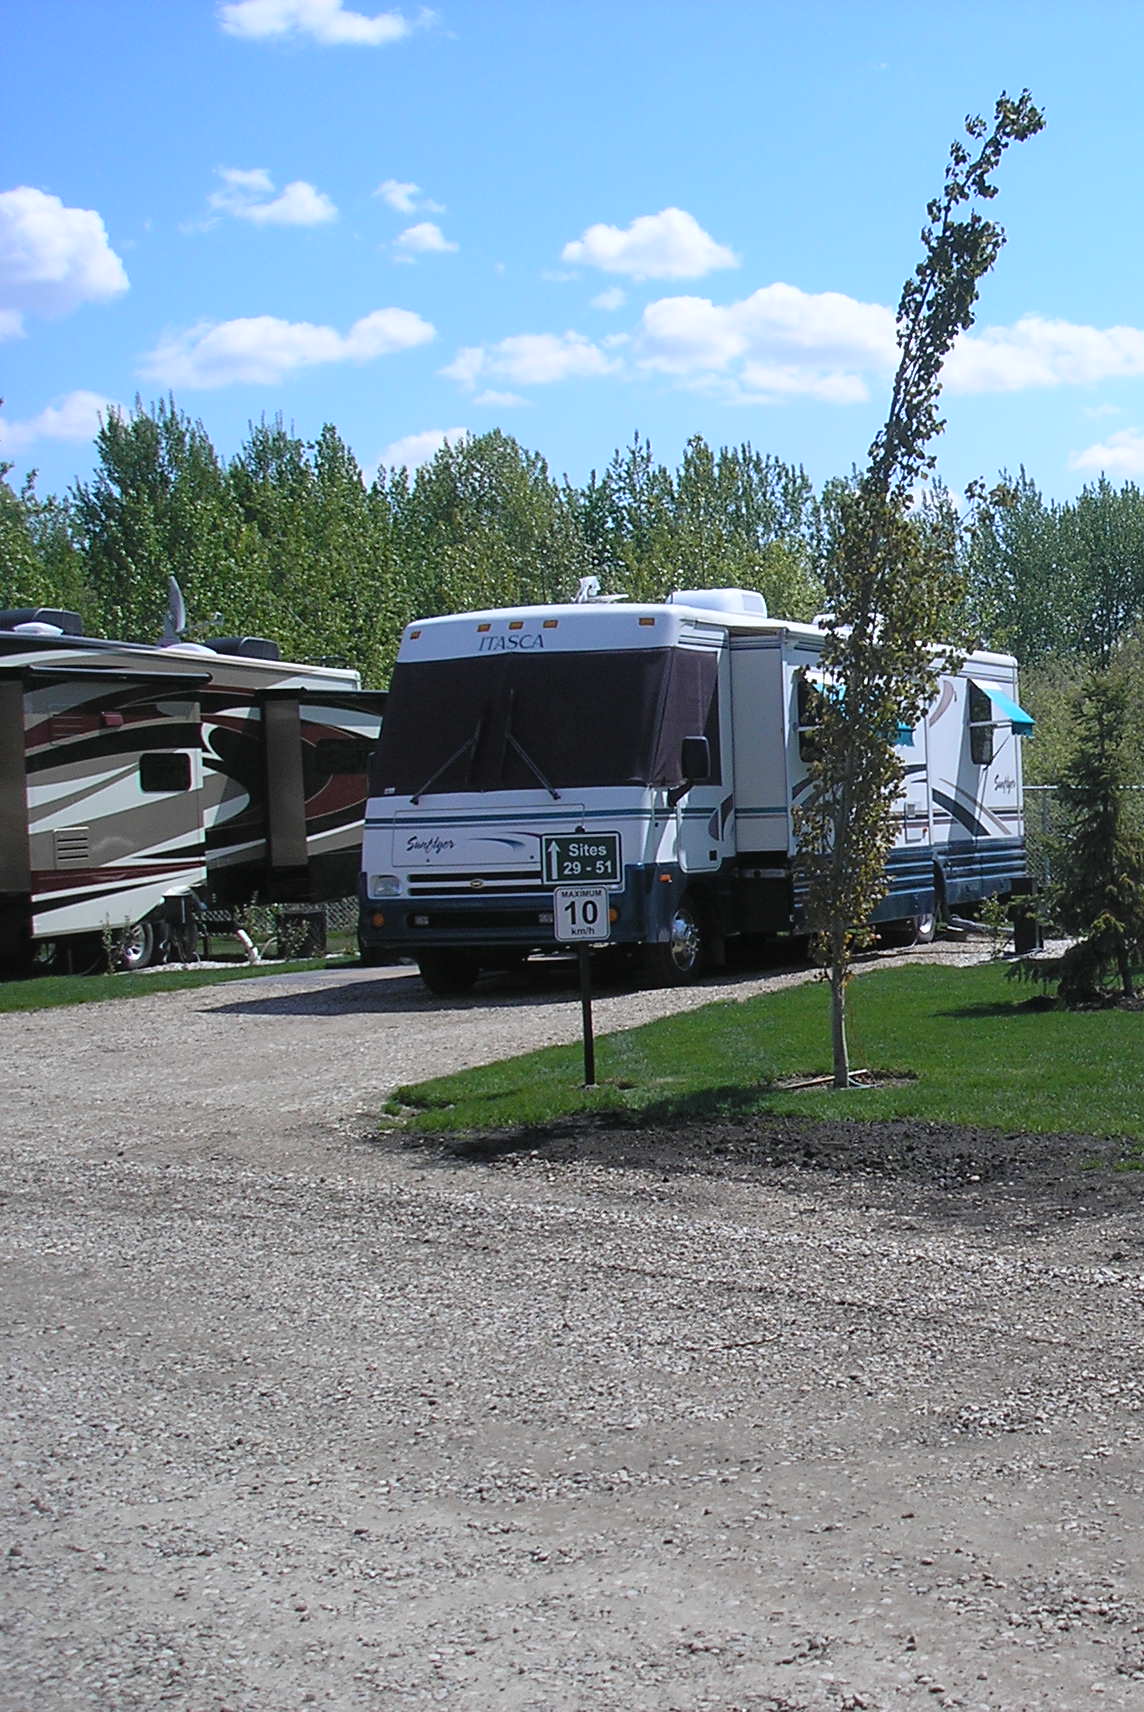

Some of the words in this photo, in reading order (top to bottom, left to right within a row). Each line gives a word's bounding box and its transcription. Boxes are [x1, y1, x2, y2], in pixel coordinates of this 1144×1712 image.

[479, 634, 544, 651] ITASCA
[568, 843, 607, 857] Sites
[563, 861, 581, 875] 29
[596, 860, 612, 874] 51
[564, 900, 598, 925] 10
[571, 927, 595, 936] km/h
